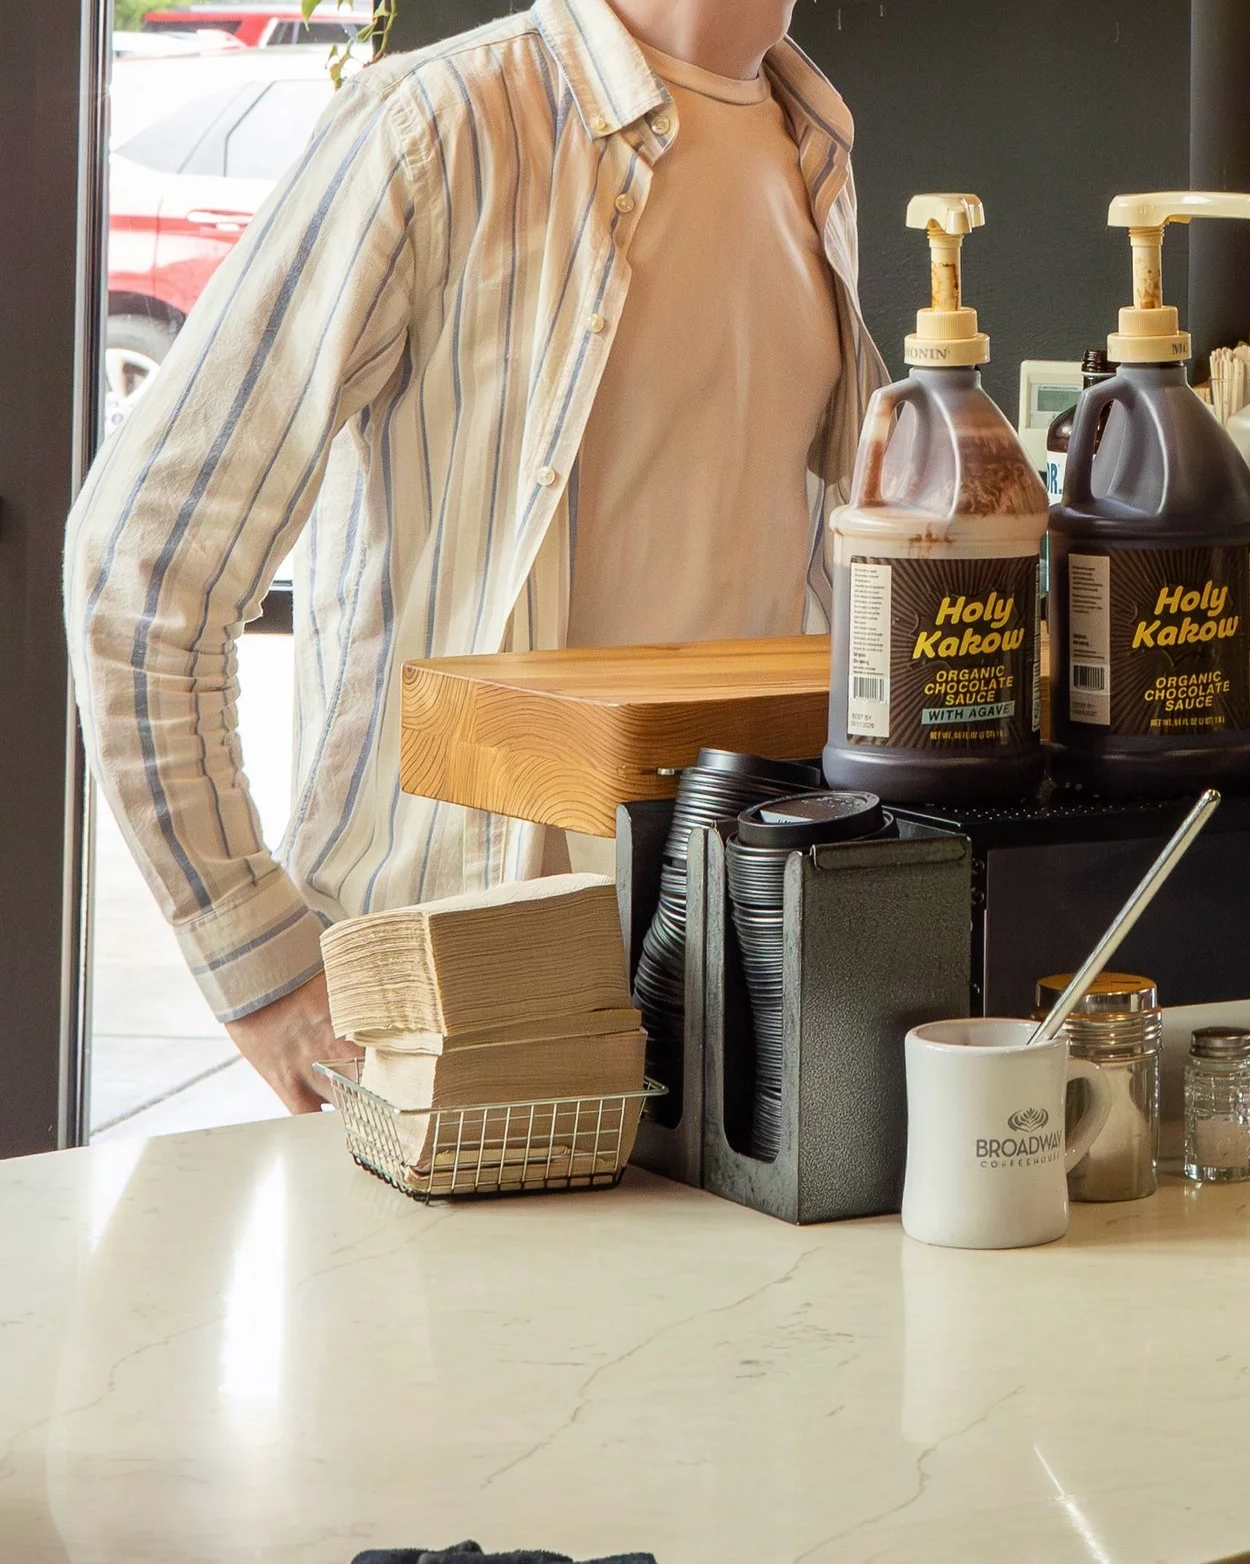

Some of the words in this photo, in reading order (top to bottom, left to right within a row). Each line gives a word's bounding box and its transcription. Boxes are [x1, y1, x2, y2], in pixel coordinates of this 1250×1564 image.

[1154, 580, 1228, 617] Holy
[935, 591, 1015, 629] Holy
[1132, 616, 1239, 649] Kakow
[912, 627, 1025, 660] Kakow
[936, 665, 1005, 683] ORGANIC
[1156, 671, 1222, 688] ORGANIC
[924, 675, 1014, 696] CHOCOLATE
[1144, 680, 1231, 701] CHOCOLATE
[945, 691, 996, 706] SAUCE
[1165, 696, 1214, 712] SAUCE
[928, 708, 964, 721] WITH
[968, 704, 1010, 719] AGAVE
[976, 1128, 1062, 1158] BROADWAY
